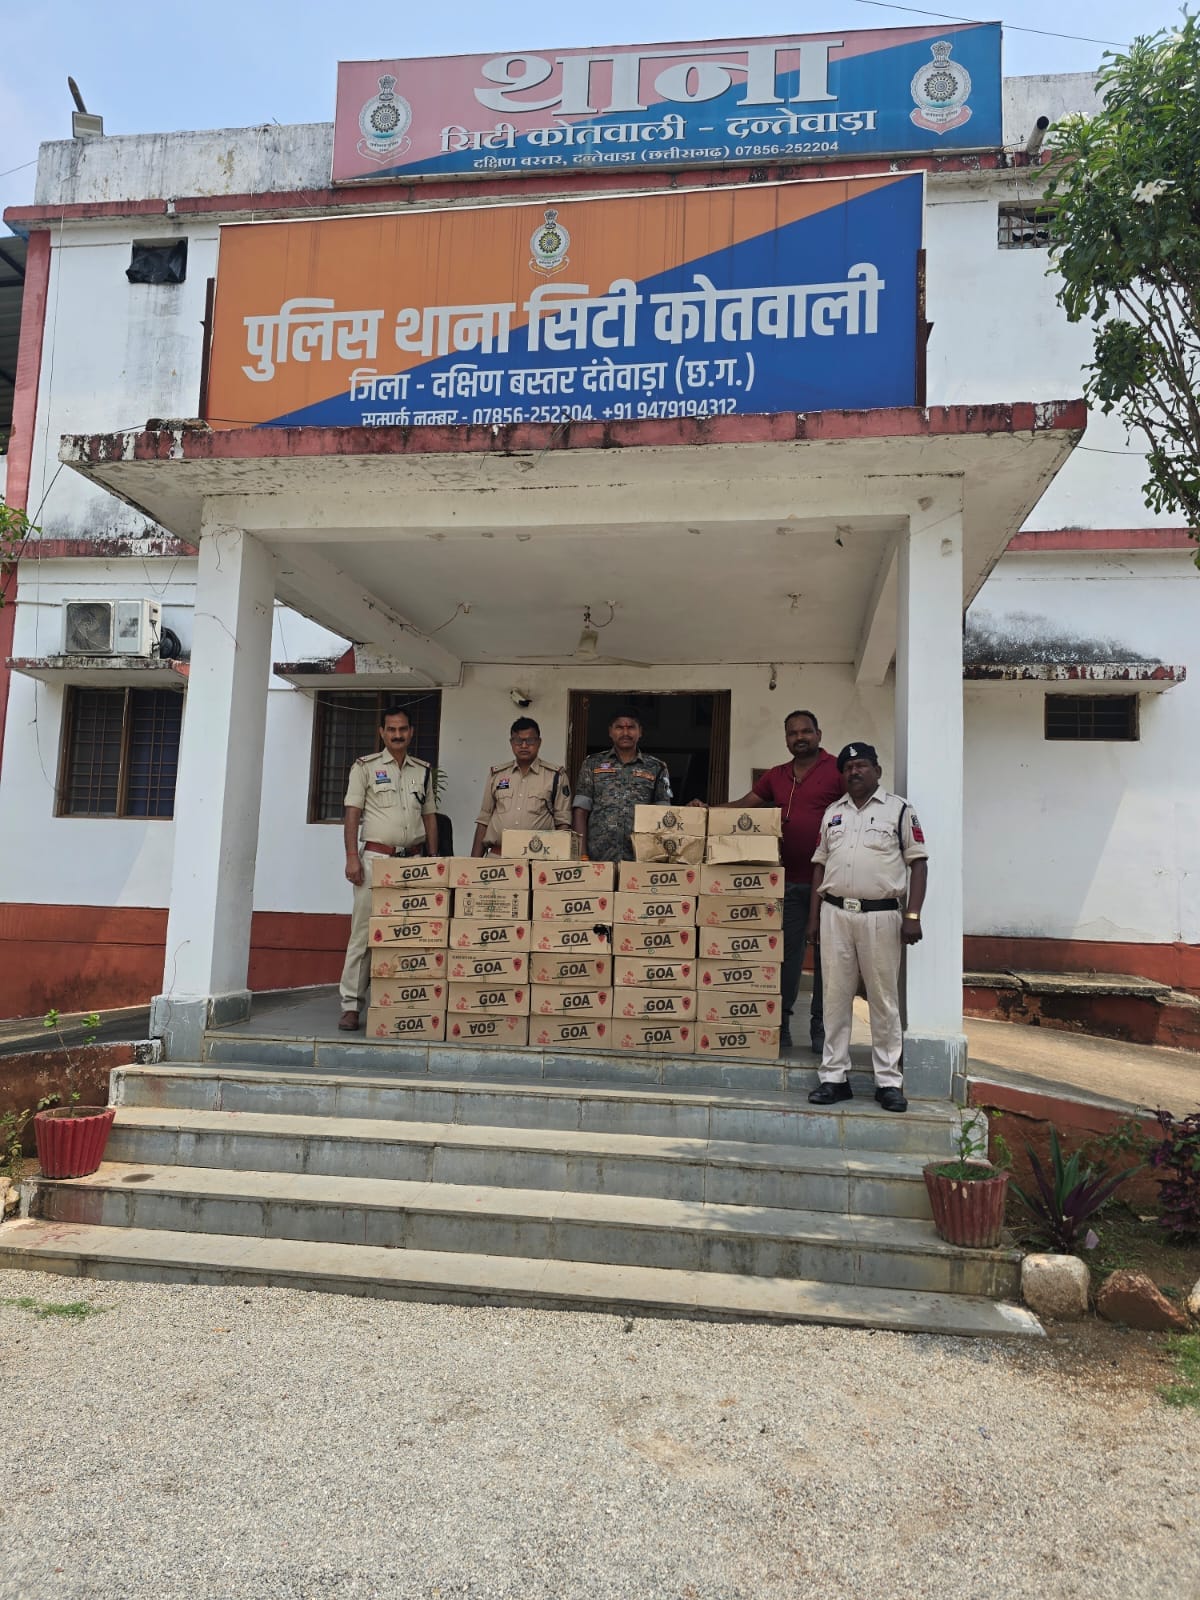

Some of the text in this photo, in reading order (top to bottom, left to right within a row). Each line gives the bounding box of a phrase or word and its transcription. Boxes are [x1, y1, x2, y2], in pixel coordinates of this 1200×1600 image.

[474, 40, 844, 115] थाना
[439, 122, 519, 152] सिटी
[526, 112, 687, 147] कोतवाली
[725, 107, 878, 139] दन्तेवाड़ा
[473, 155, 517, 169] दक्षिण
[735, 140, 840, 157] 07856-252204
[241, 262, 886, 382] पुलिस थाना सिटी कोतवाली
[348, 367, 411, 402] जिला
[431, 363, 504, 399] दक्षिण
[508, 366, 578, 396] बस्तर
[581, 356, 668, 397] दंतेवाड़ा
[675, 351, 756, 395] (छ.ग.)
[602, 402, 632, 420] +91
[637, 398, 737, 419] 9479194312
[402, 867, 429, 879] GOA
[480, 868, 506, 880] GOA
[555, 868, 582, 881] GOA
[650, 873, 677, 884] GOA
[734, 876, 761, 887] GOA
[402, 897, 427, 909] GOA
[565, 901, 591, 913] GOA
[646, 904, 673, 916] GOA
[730, 907, 757, 919] GOA
[394, 925, 421, 938] GOA
[481, 929, 507, 942] GOA
[562, 932, 588, 945] GOA
[644, 934, 671, 947] GOA
[732, 939, 759, 950] GOA
[401, 957, 426, 969] GOA
[474, 962, 502, 973] GOA
[560, 964, 587, 976] GOA
[647, 967, 674, 979] GOA
[723, 970, 752, 982] GOA
[401, 988, 426, 1000] GOA
[479, 993, 506, 1005] GOA
[563, 995, 590, 1007] GOA
[647, 999, 673, 1011] GOA
[730, 1003, 757, 1015] GOA
[398, 1019, 423, 1031] GOA
[470, 1022, 495, 1034] GOA
[561, 1026, 588, 1039] GOA
[645, 1030, 672, 1042] GOA
[719, 1034, 747, 1046] GOA
